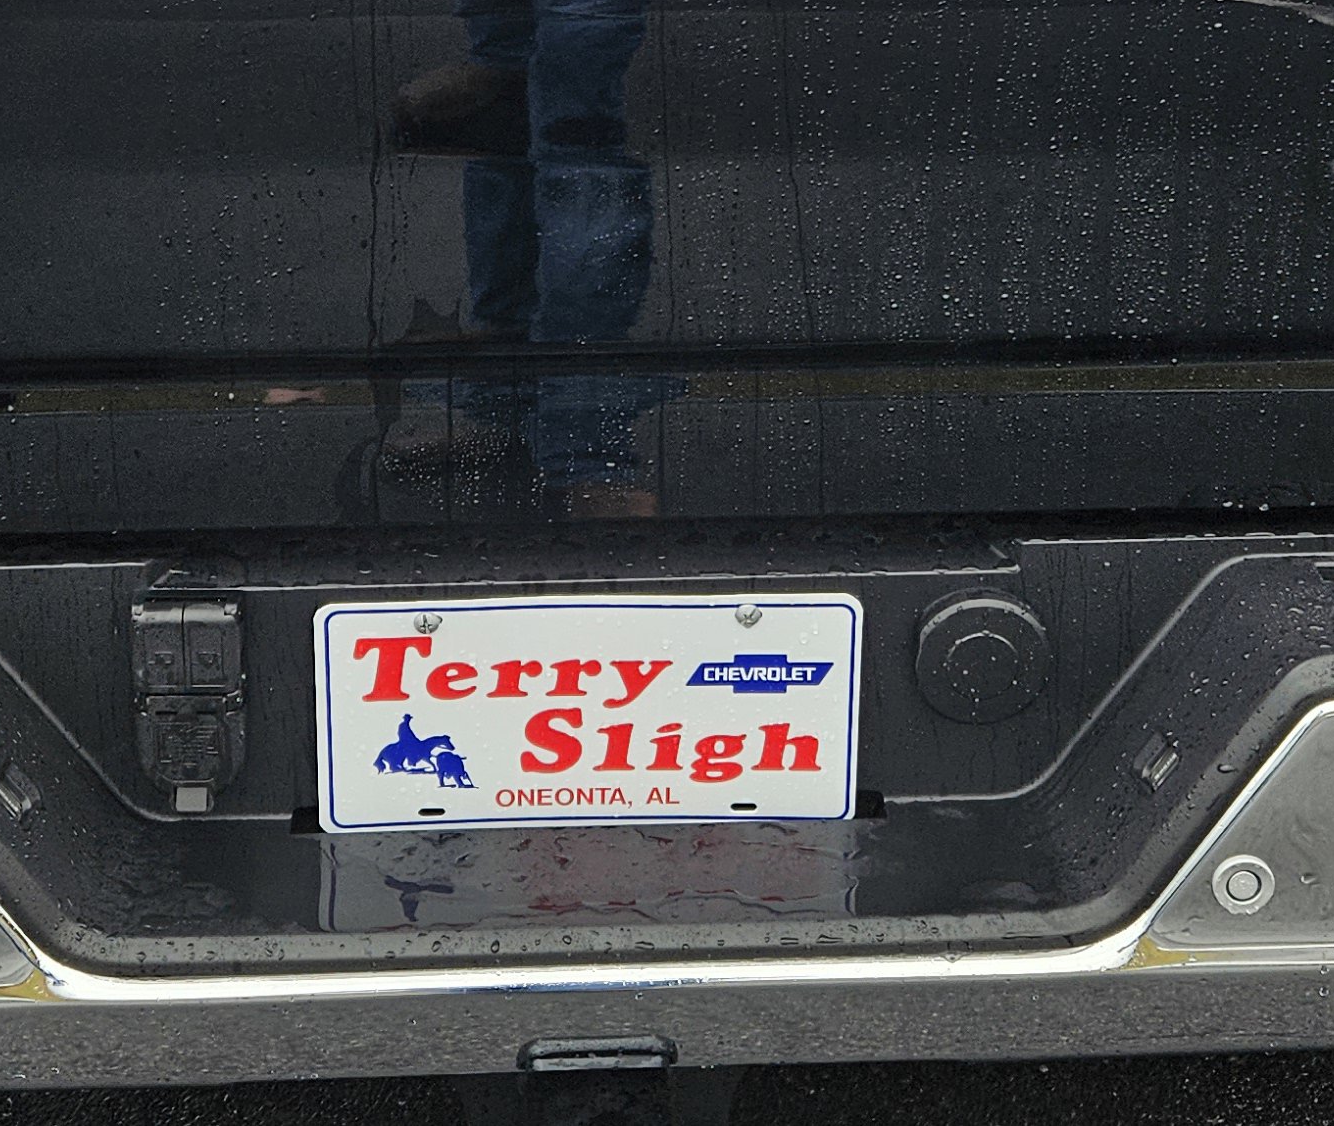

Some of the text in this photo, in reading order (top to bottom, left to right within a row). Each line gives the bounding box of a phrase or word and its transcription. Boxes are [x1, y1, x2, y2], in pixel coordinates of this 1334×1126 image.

[353, 636, 673, 708] Terry
[703, 665, 817, 684] CHEVROLET
[520, 707, 822, 783] Sligh
[495, 786, 681, 809] ONEONTA, AL
